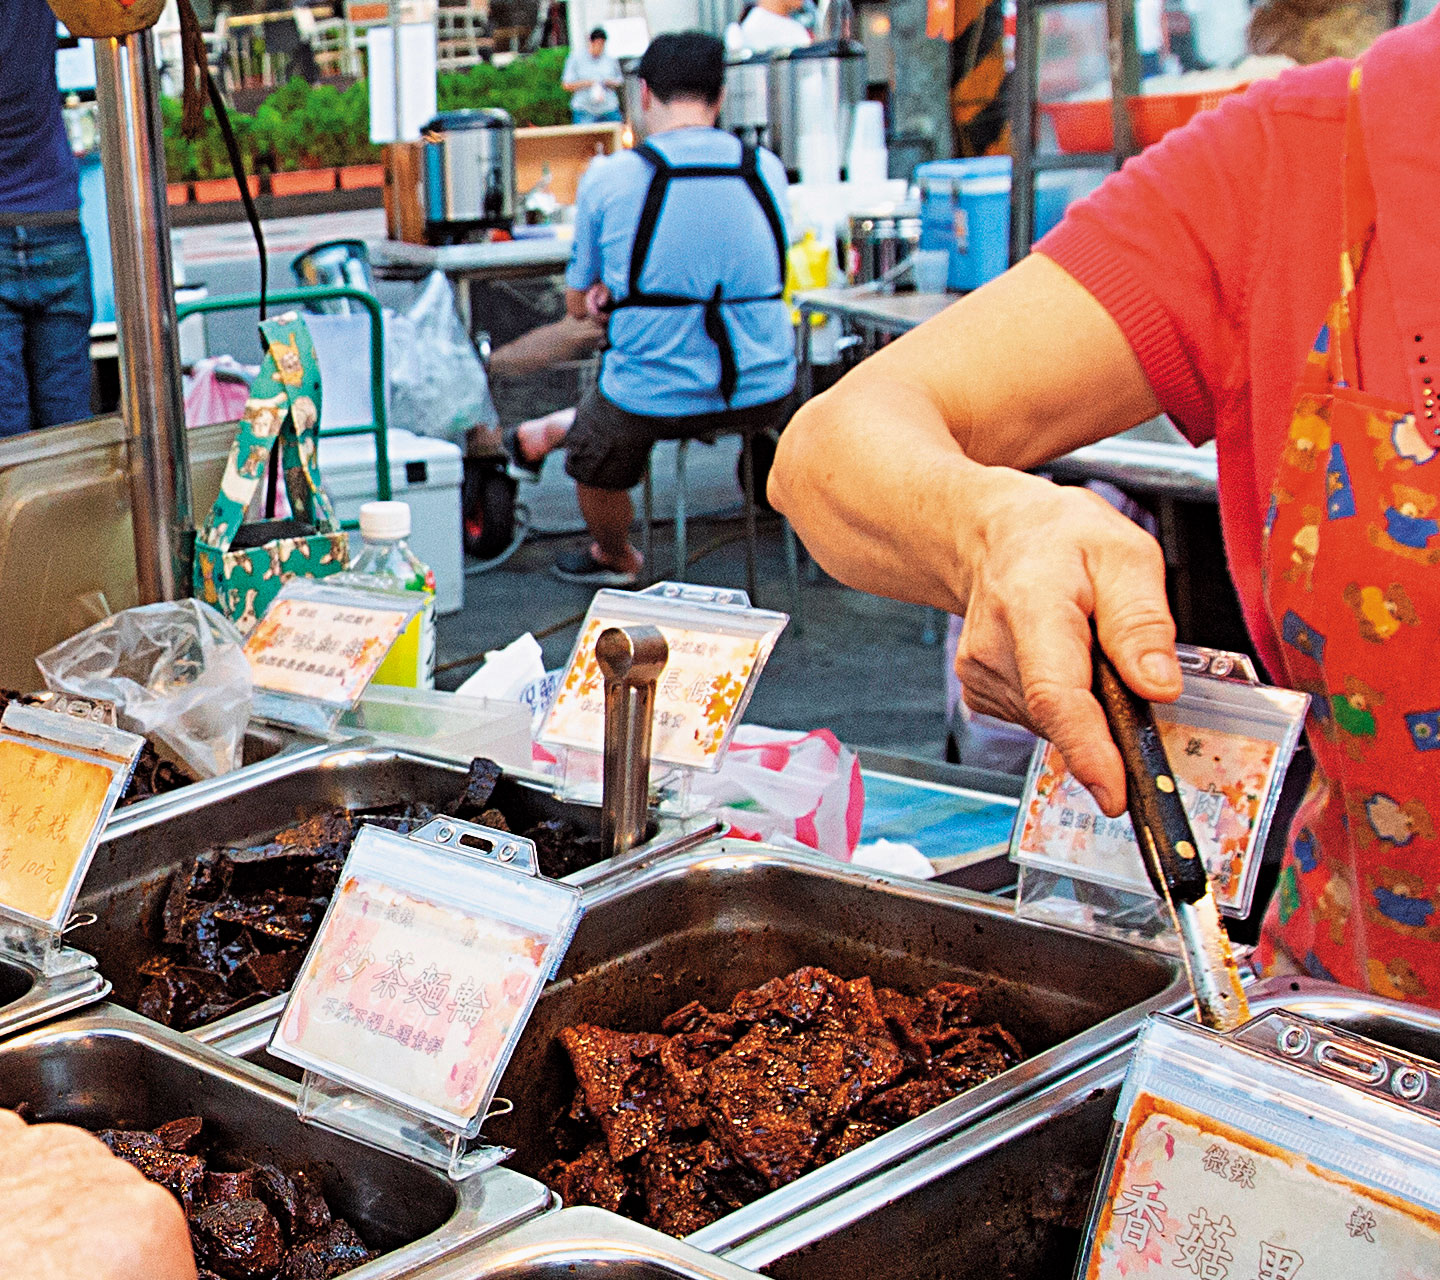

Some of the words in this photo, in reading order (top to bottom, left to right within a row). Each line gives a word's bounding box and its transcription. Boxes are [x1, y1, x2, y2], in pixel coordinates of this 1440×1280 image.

[335, 944, 493, 1030] 沙茶麵輪
[1202, 1143, 1256, 1190] 微辣
[1346, 1206, 1376, 1243] 軟
